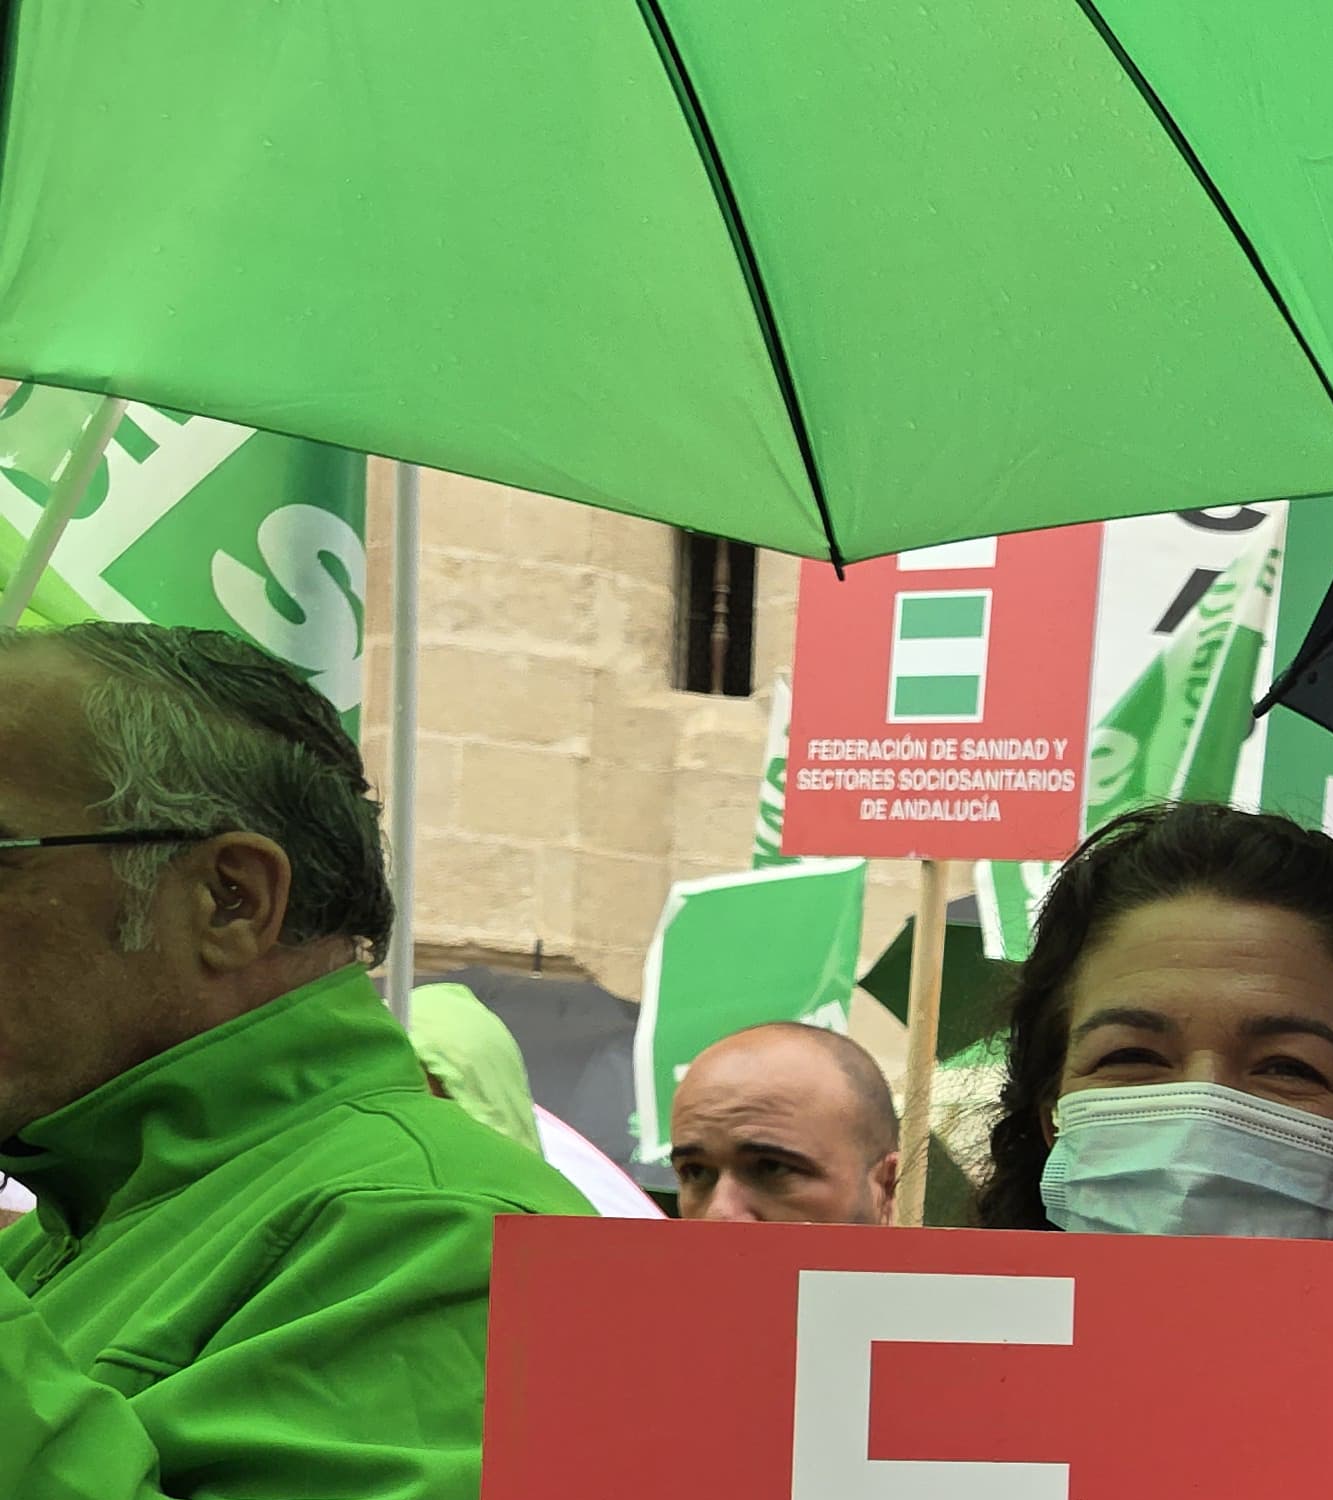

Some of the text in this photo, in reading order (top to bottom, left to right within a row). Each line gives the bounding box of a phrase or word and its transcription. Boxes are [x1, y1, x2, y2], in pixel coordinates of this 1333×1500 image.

[807, 733, 1069, 761] FEDERACIÓN DE SANIDAD Y
[796, 768, 1076, 792] SECTORES SOCIOSANITARIOS
[859, 795, 1001, 821] DE ANDALUCÍA
